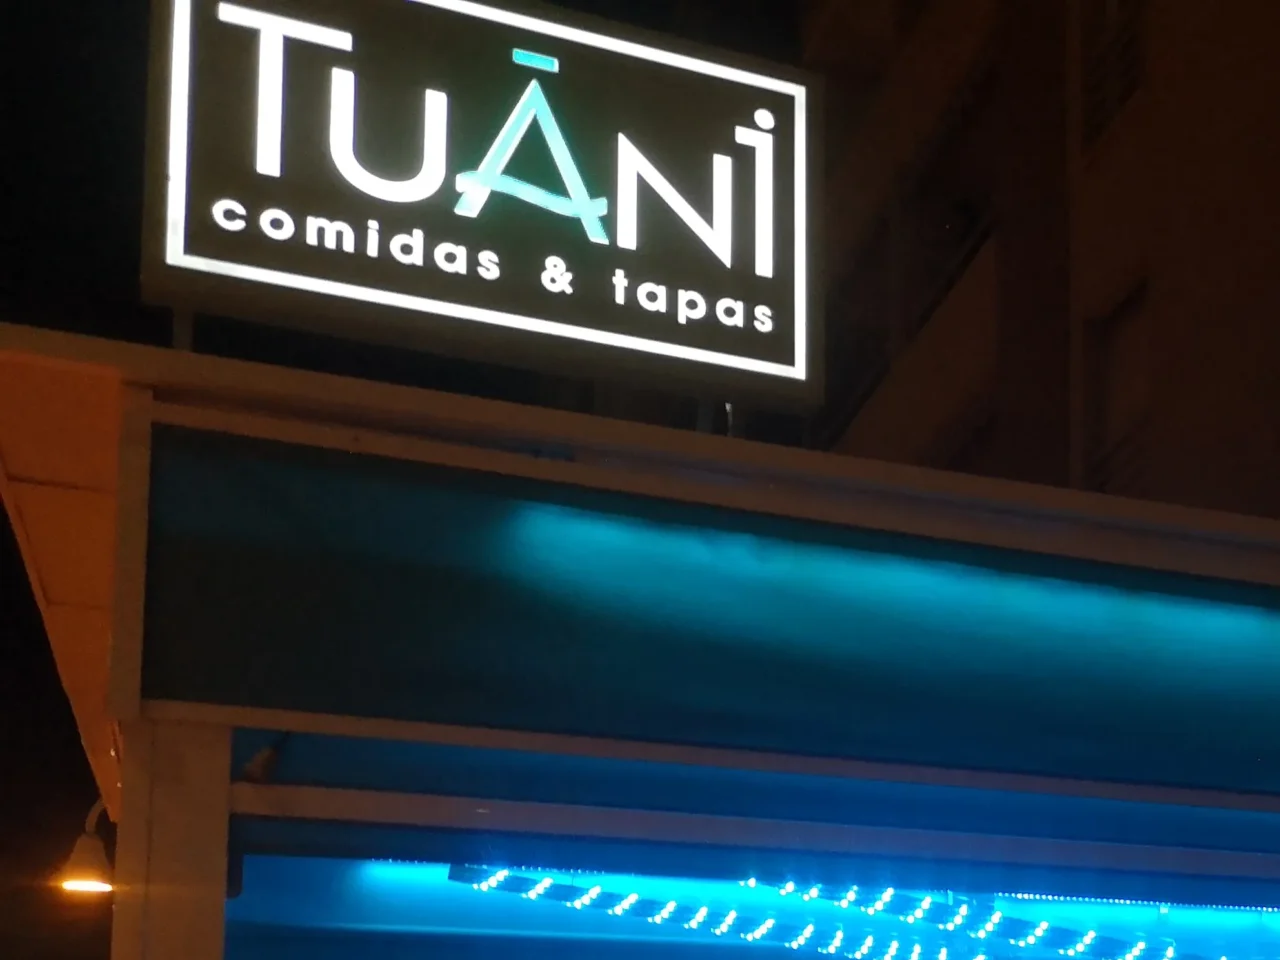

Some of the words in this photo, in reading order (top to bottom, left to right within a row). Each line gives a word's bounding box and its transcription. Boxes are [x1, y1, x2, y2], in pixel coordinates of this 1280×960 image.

[211, 197, 501, 281] comidas
[540, 255, 574, 295] &
[612, 269, 775, 333] tapas
